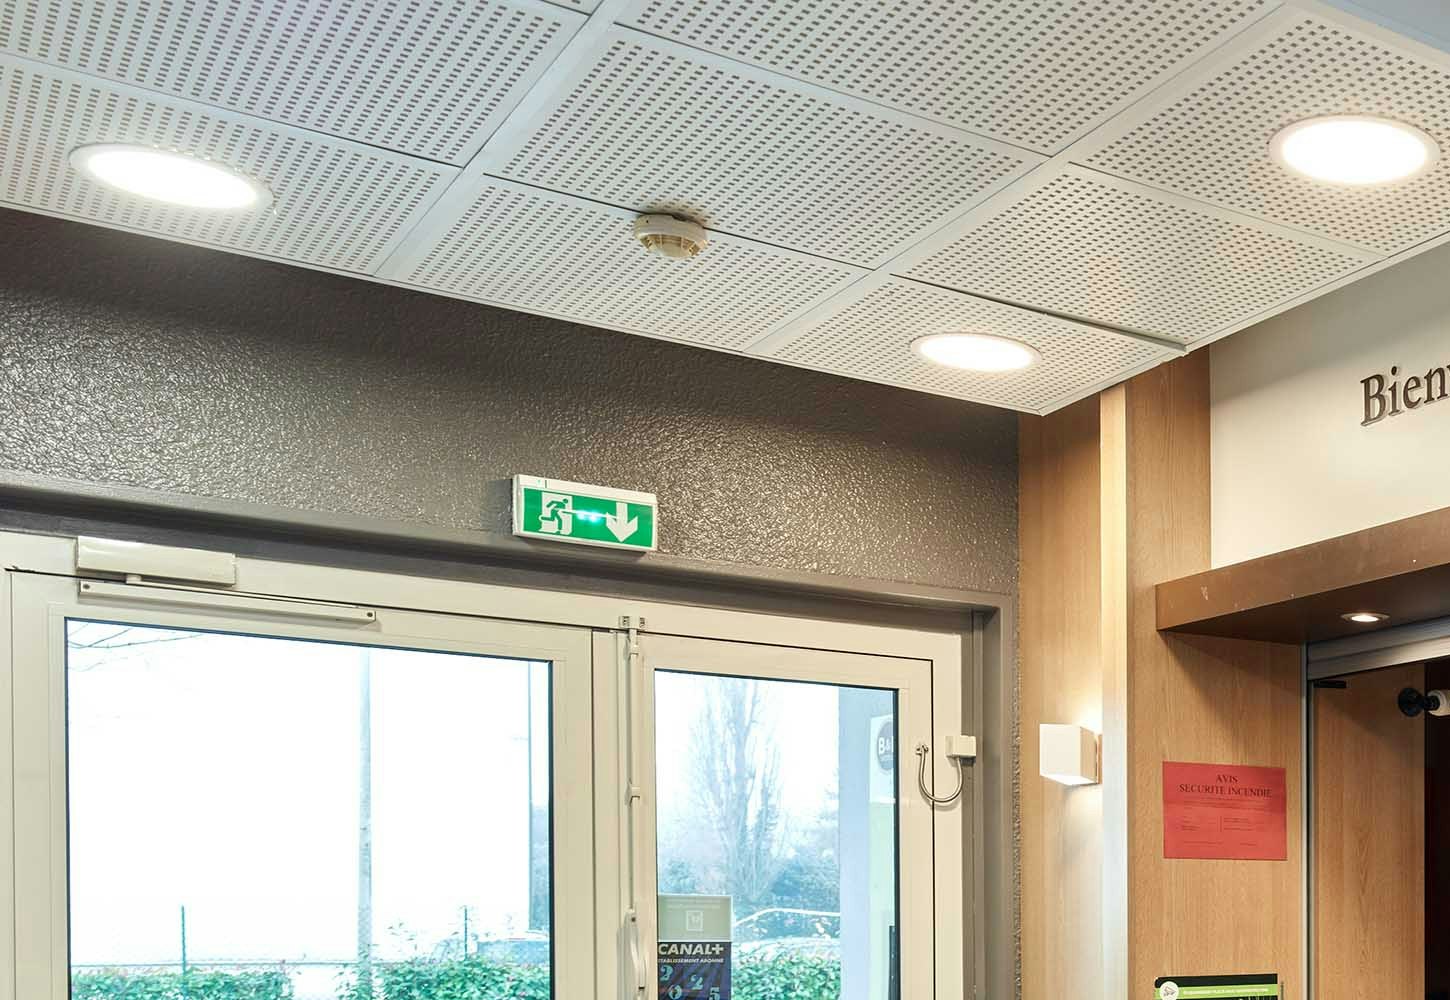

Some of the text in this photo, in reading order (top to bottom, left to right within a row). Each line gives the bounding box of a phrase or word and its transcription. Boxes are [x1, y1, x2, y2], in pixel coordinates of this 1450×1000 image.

[1216, 774, 1238, 783] AVIS
[1179, 784, 1273, 798] SECURITE INCENDIE
[658, 944, 724, 955] CANAL+
